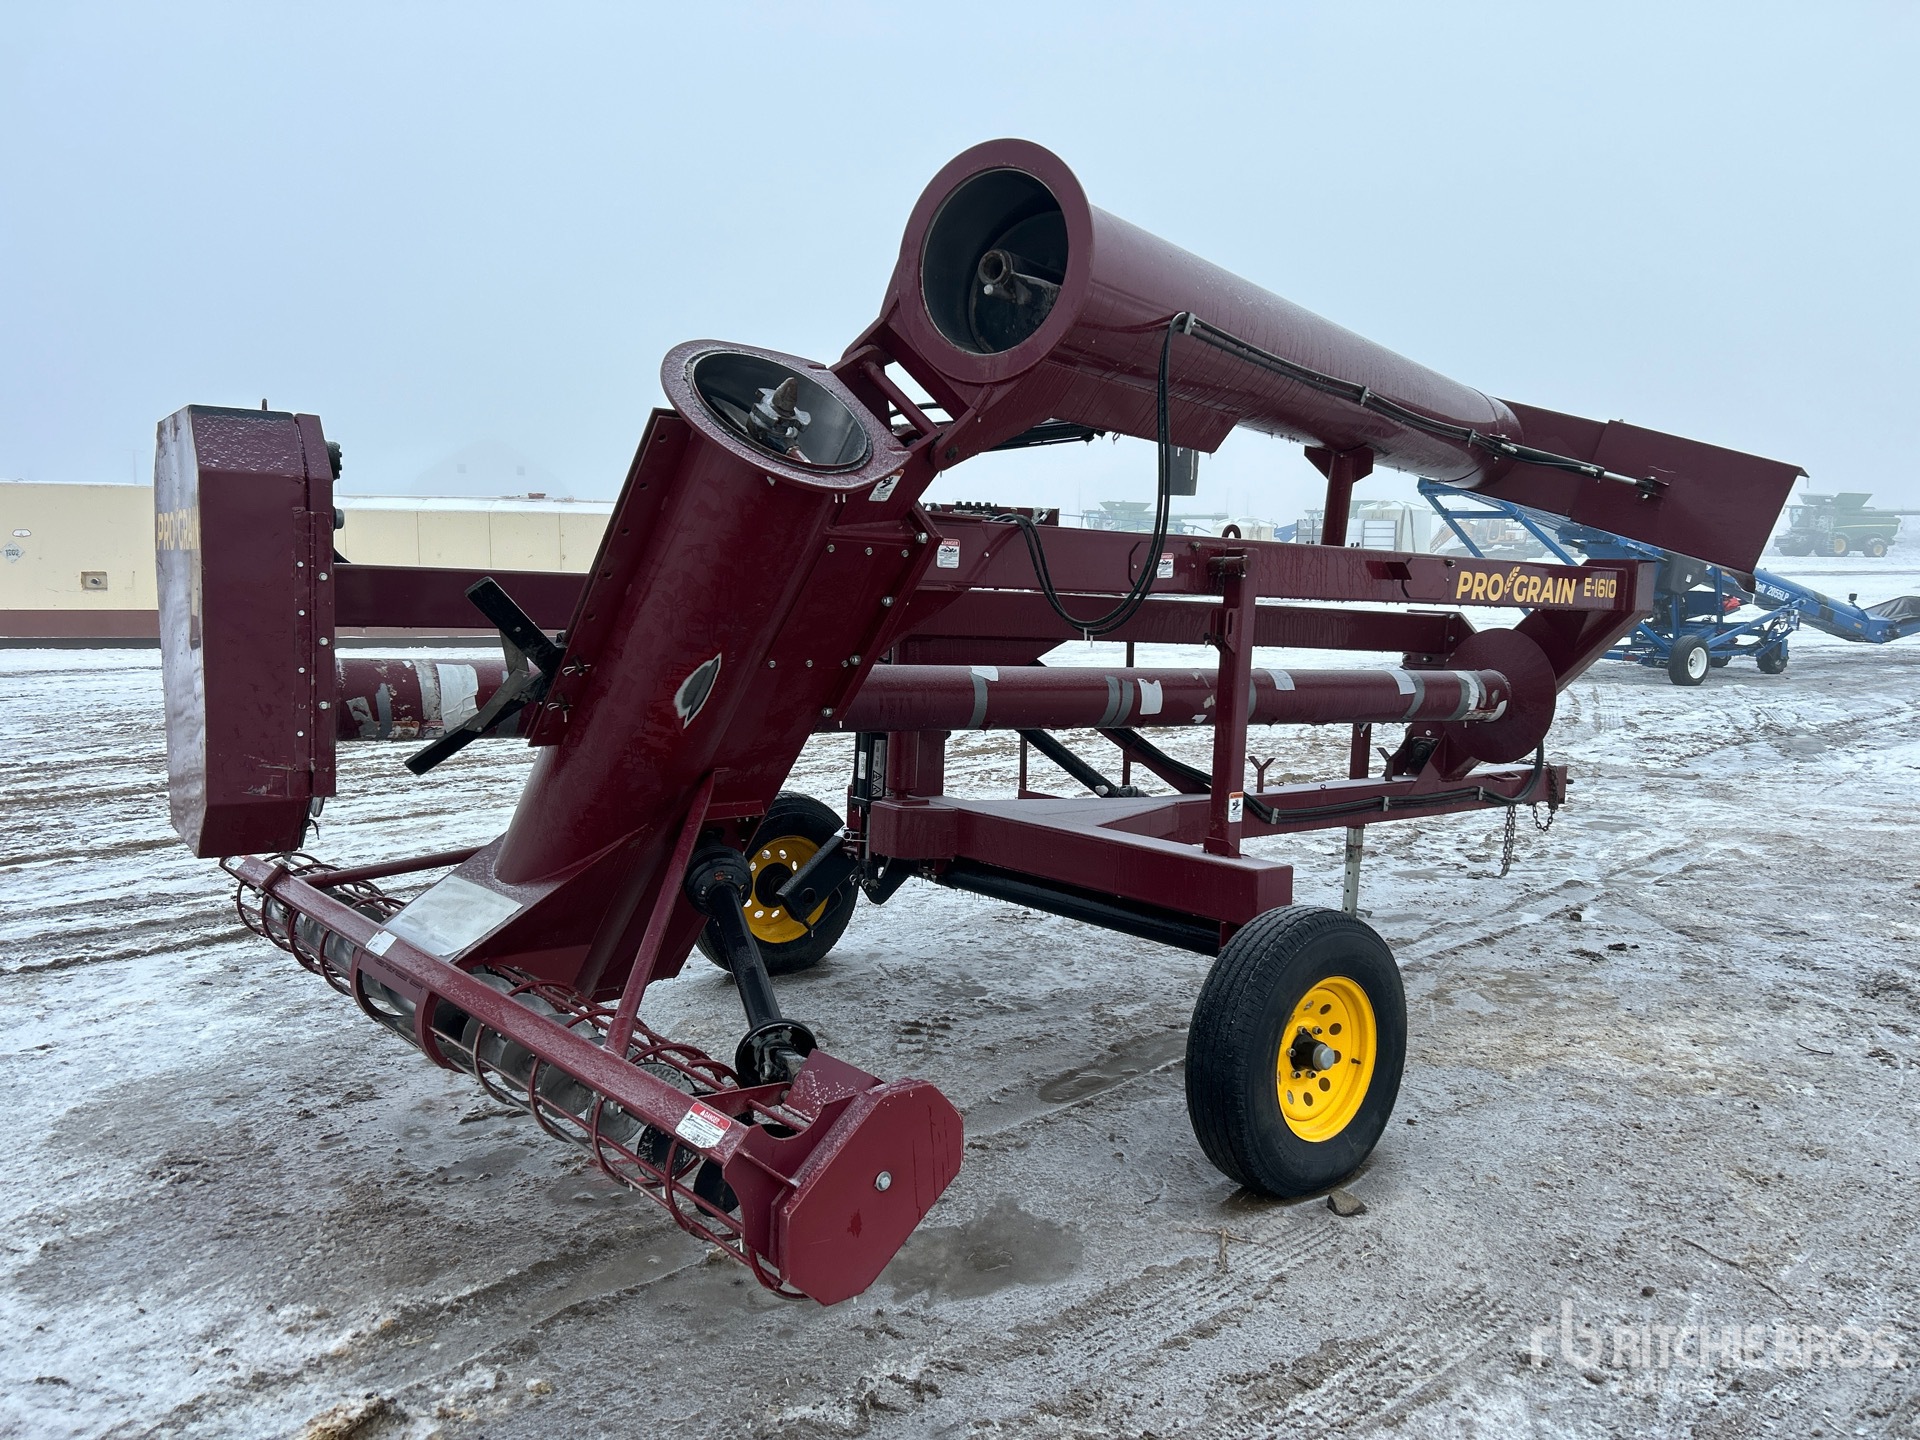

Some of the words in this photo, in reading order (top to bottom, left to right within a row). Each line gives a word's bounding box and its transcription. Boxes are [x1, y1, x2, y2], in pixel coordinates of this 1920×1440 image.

[157, 512, 175, 550] PRO
[1455, 571, 1504, 601] PRO
[1513, 575, 1577, 604] GRAIN
[1583, 577, 1617, 598] E-1610
